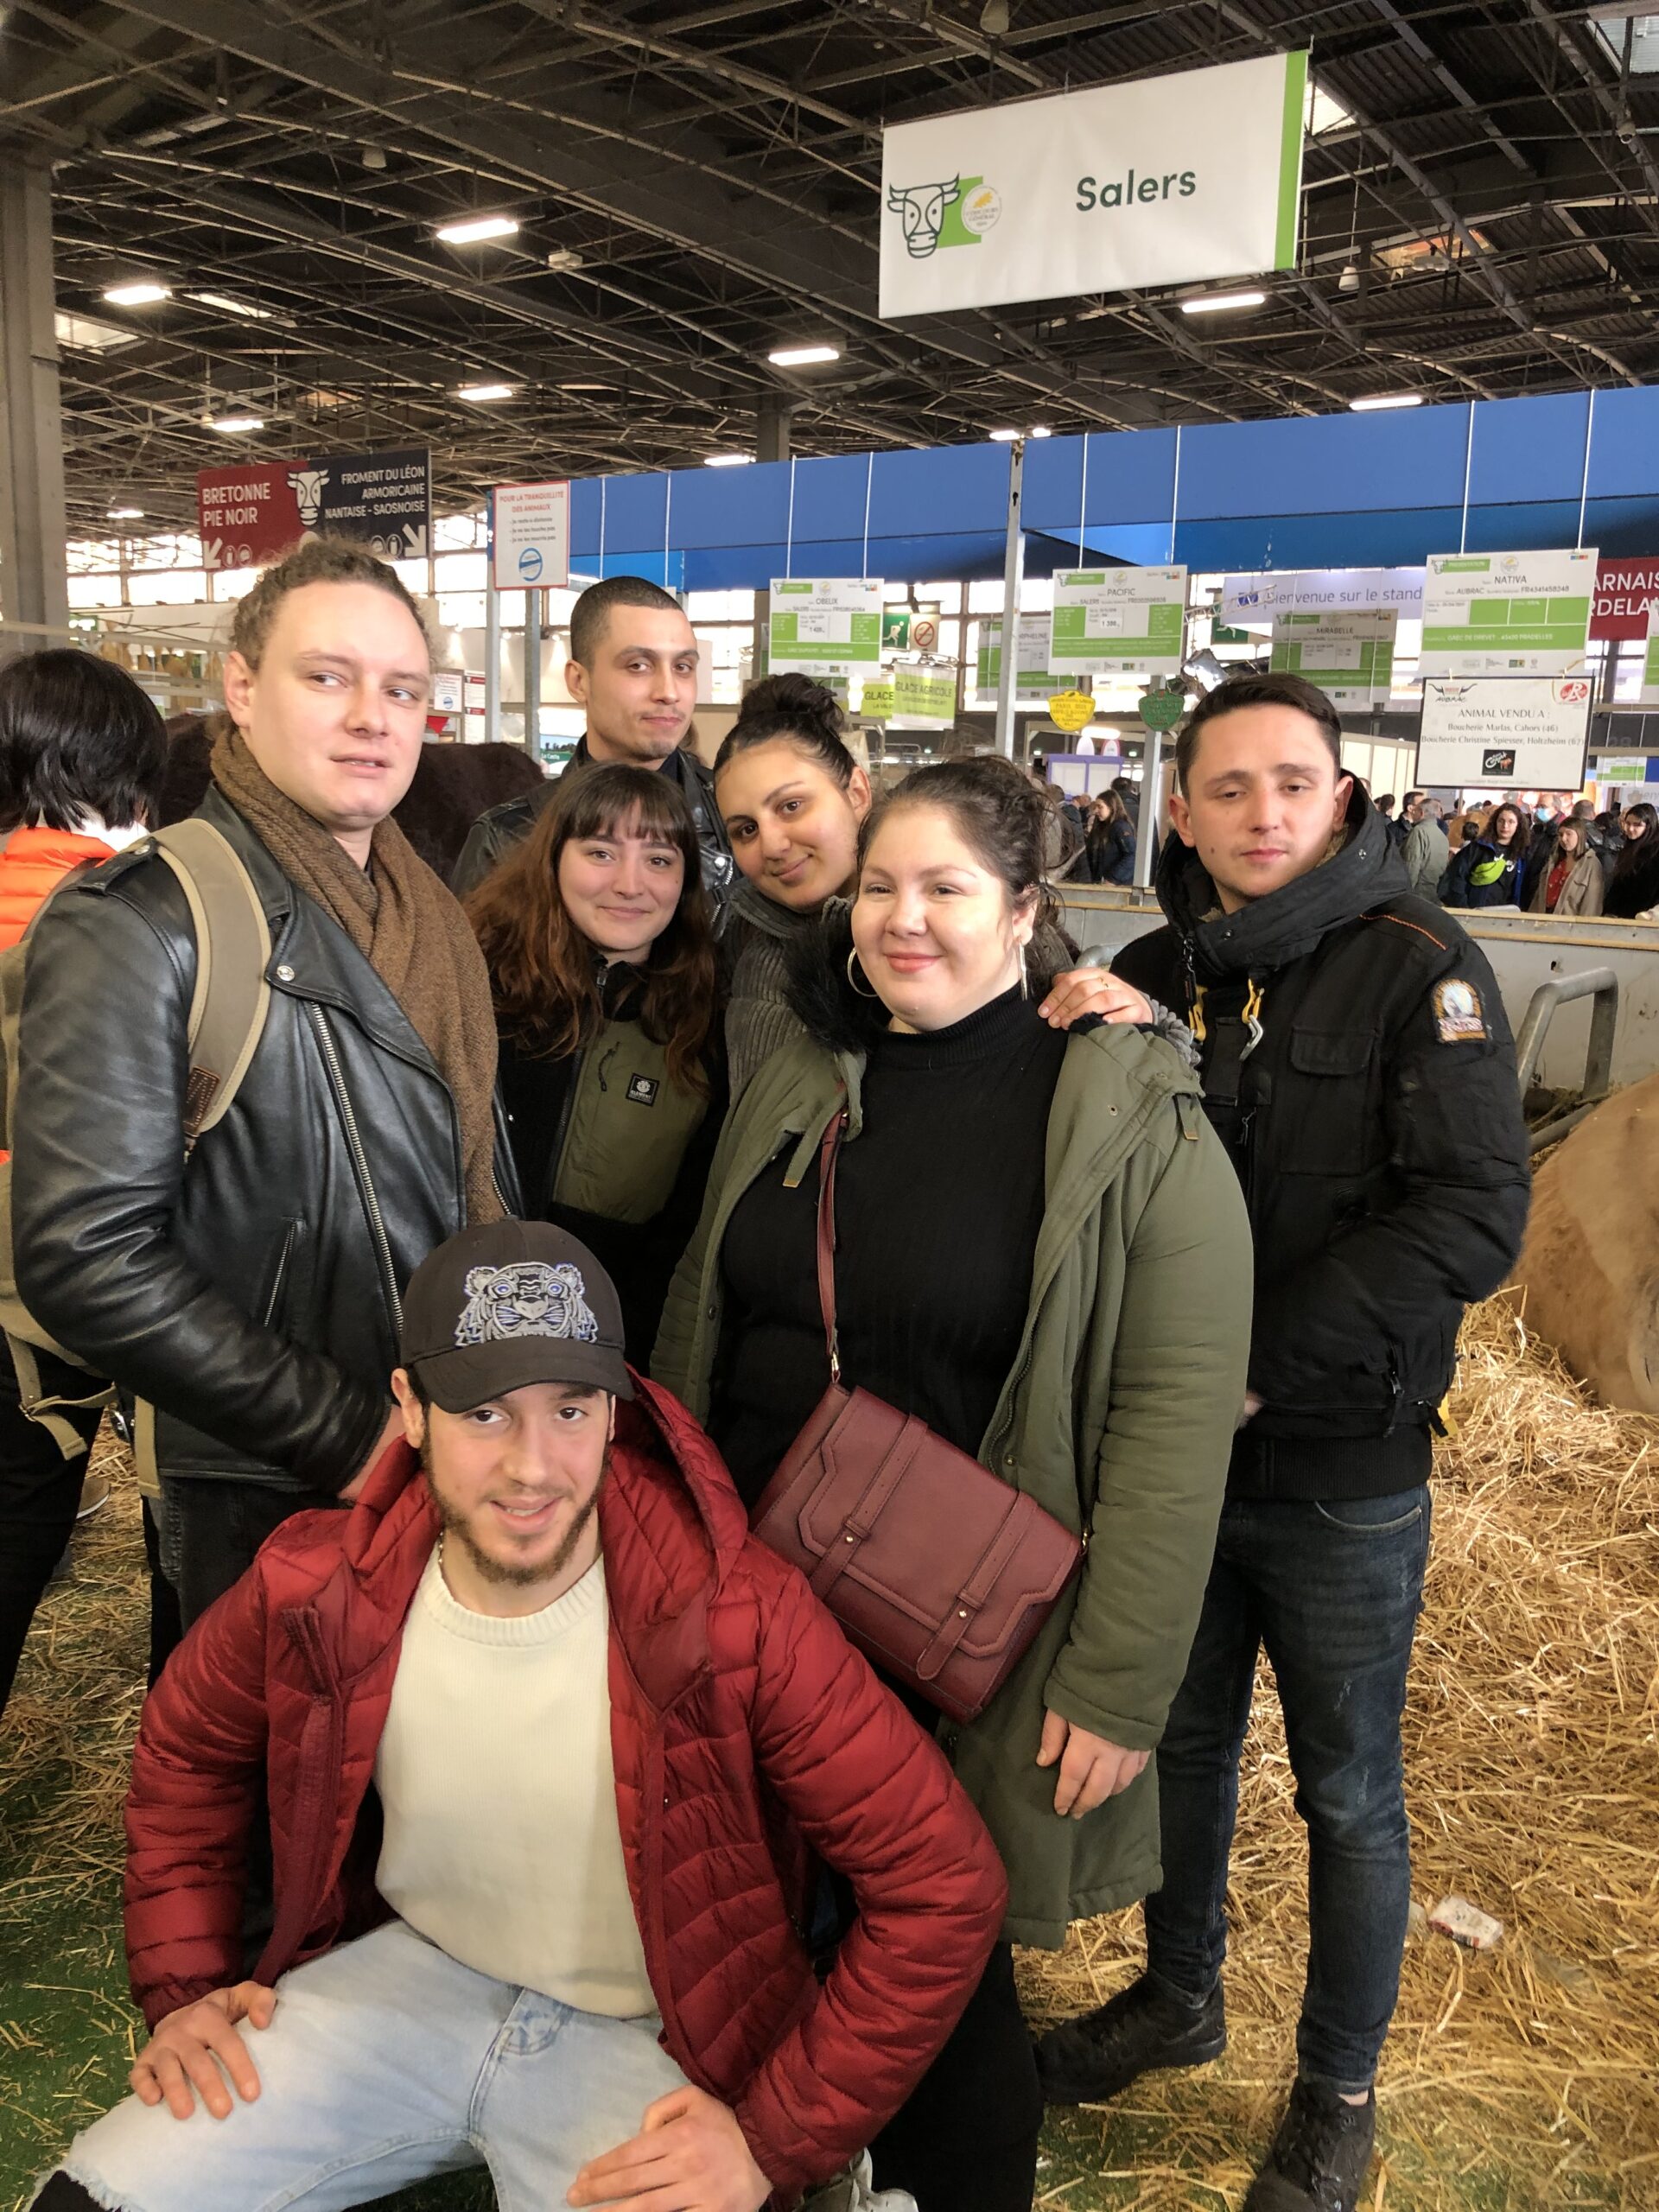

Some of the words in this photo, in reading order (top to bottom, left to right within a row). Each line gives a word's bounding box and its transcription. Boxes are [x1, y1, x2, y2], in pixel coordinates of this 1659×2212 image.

[1076, 168, 1197, 212] Salers
[341, 470, 384, 485] FROMENT
[385, 468, 398, 480] DU
[401, 464, 425, 479] LÉON
[202, 482, 271, 505] BRETONNE
[361, 483, 425, 499] ARMORICAINE
[203, 510, 223, 527] PIE
[226, 506, 258, 526] NOIR
[324, 505, 366, 519] NANTAISE
[372, 500, 425, 516] SAOSNOISE
[1494, 575, 1527, 585] NATIVA
[1107, 588, 1135, 597] PACIFIC
[1339, 592, 1362, 602] sur
[1366, 588, 1376, 601] le
[1382, 587, 1422, 601] stand
[864, 691, 893, 701] GLACE
[895, 681, 918, 693] GLACE
[919, 685, 952, 697] AGRICOLE
[1458, 709, 1497, 718] ANIMAL
[1499, 709, 1535, 718] VENDU
[1536, 709, 1545, 718] A
[1447, 722, 1484, 731] Boucherie
[1541, 724, 1559, 733] (46)
[1458, 735, 1491, 744] Christine
[1493, 736, 1525, 746] Spiesser,
[1527, 737, 1567, 746] Holtzheim
[1567, 737, 1585, 747] (67)
